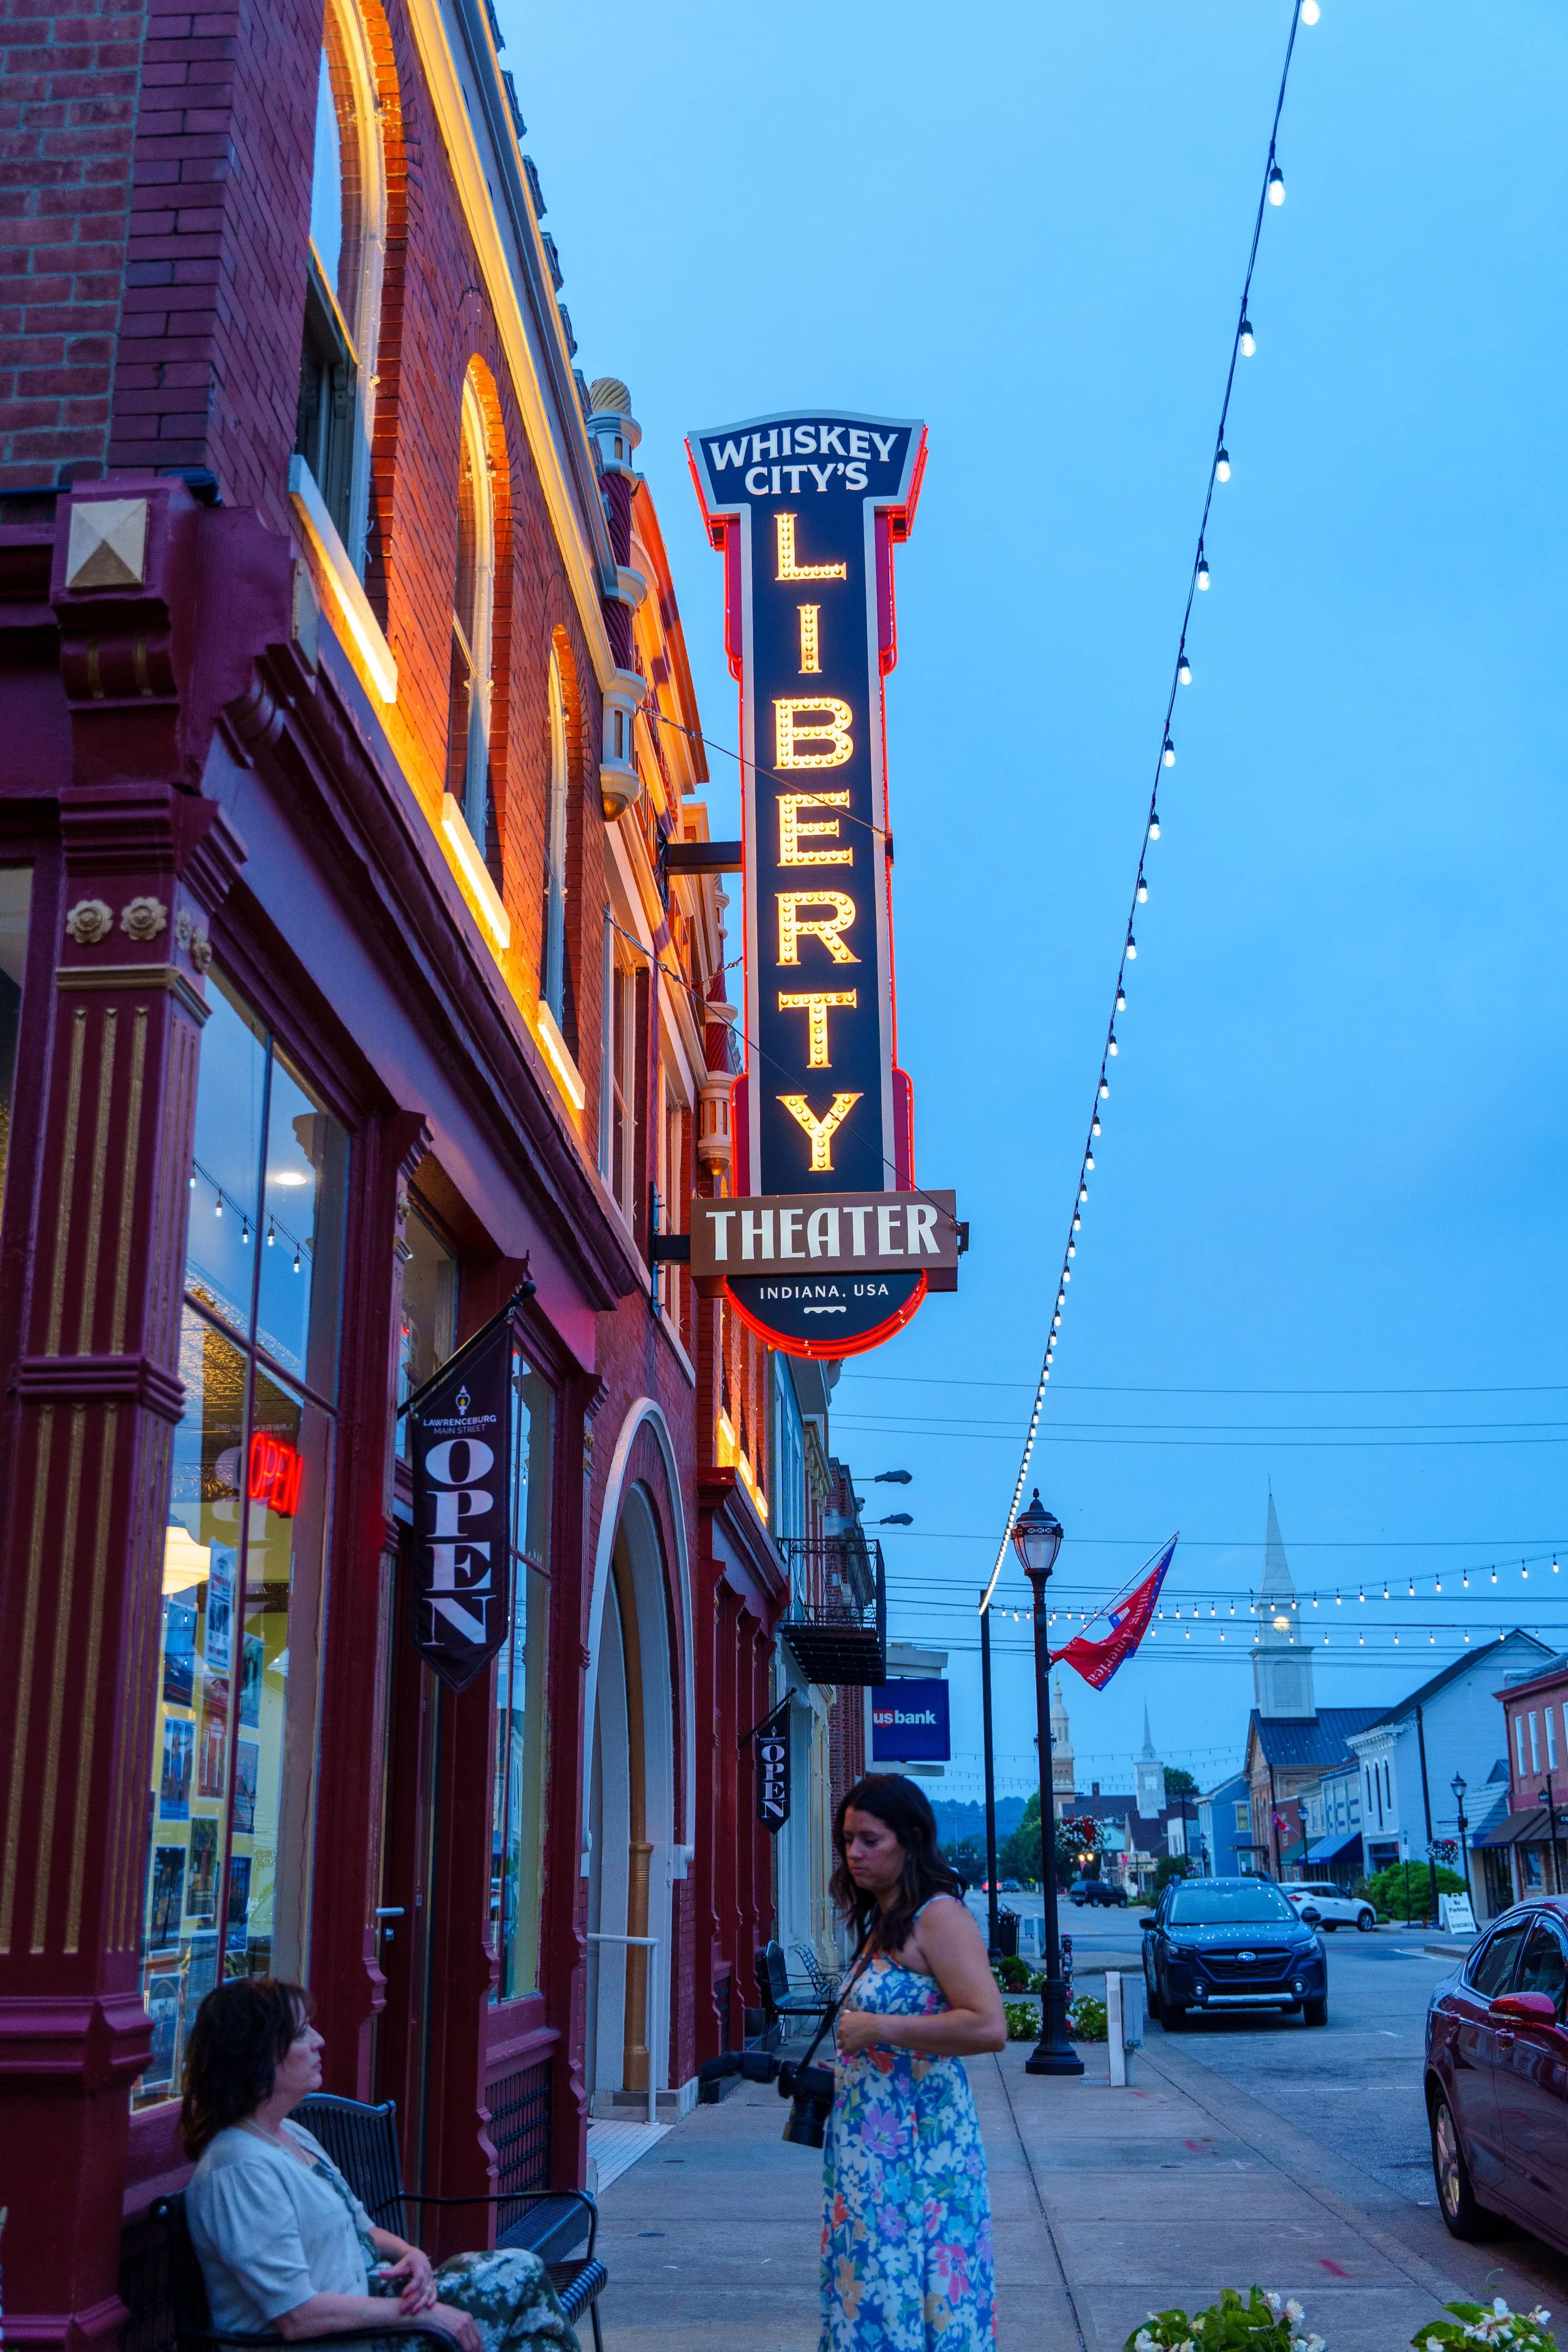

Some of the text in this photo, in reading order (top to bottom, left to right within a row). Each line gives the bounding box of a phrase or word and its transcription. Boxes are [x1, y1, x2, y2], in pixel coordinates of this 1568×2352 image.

[709, 425, 898, 471] WHISKEY
[744, 462, 869, 495] CITY'S
[773, 513, 863, 1171] LIBERTY
[706, 1204, 941, 1261] THEATER
[760, 1283, 889, 1300] INDIANA, USA
[423, 1414, 497, 1427] LAWRENCEBURG
[433, 1424, 486, 1434] MAIN STREET
[249, 1432, 304, 1516] OPEN
[422, 1438, 497, 1646] OPEN
[1086, 1628, 1135, 1682] America
[761, 1744, 787, 1818] OPEN
